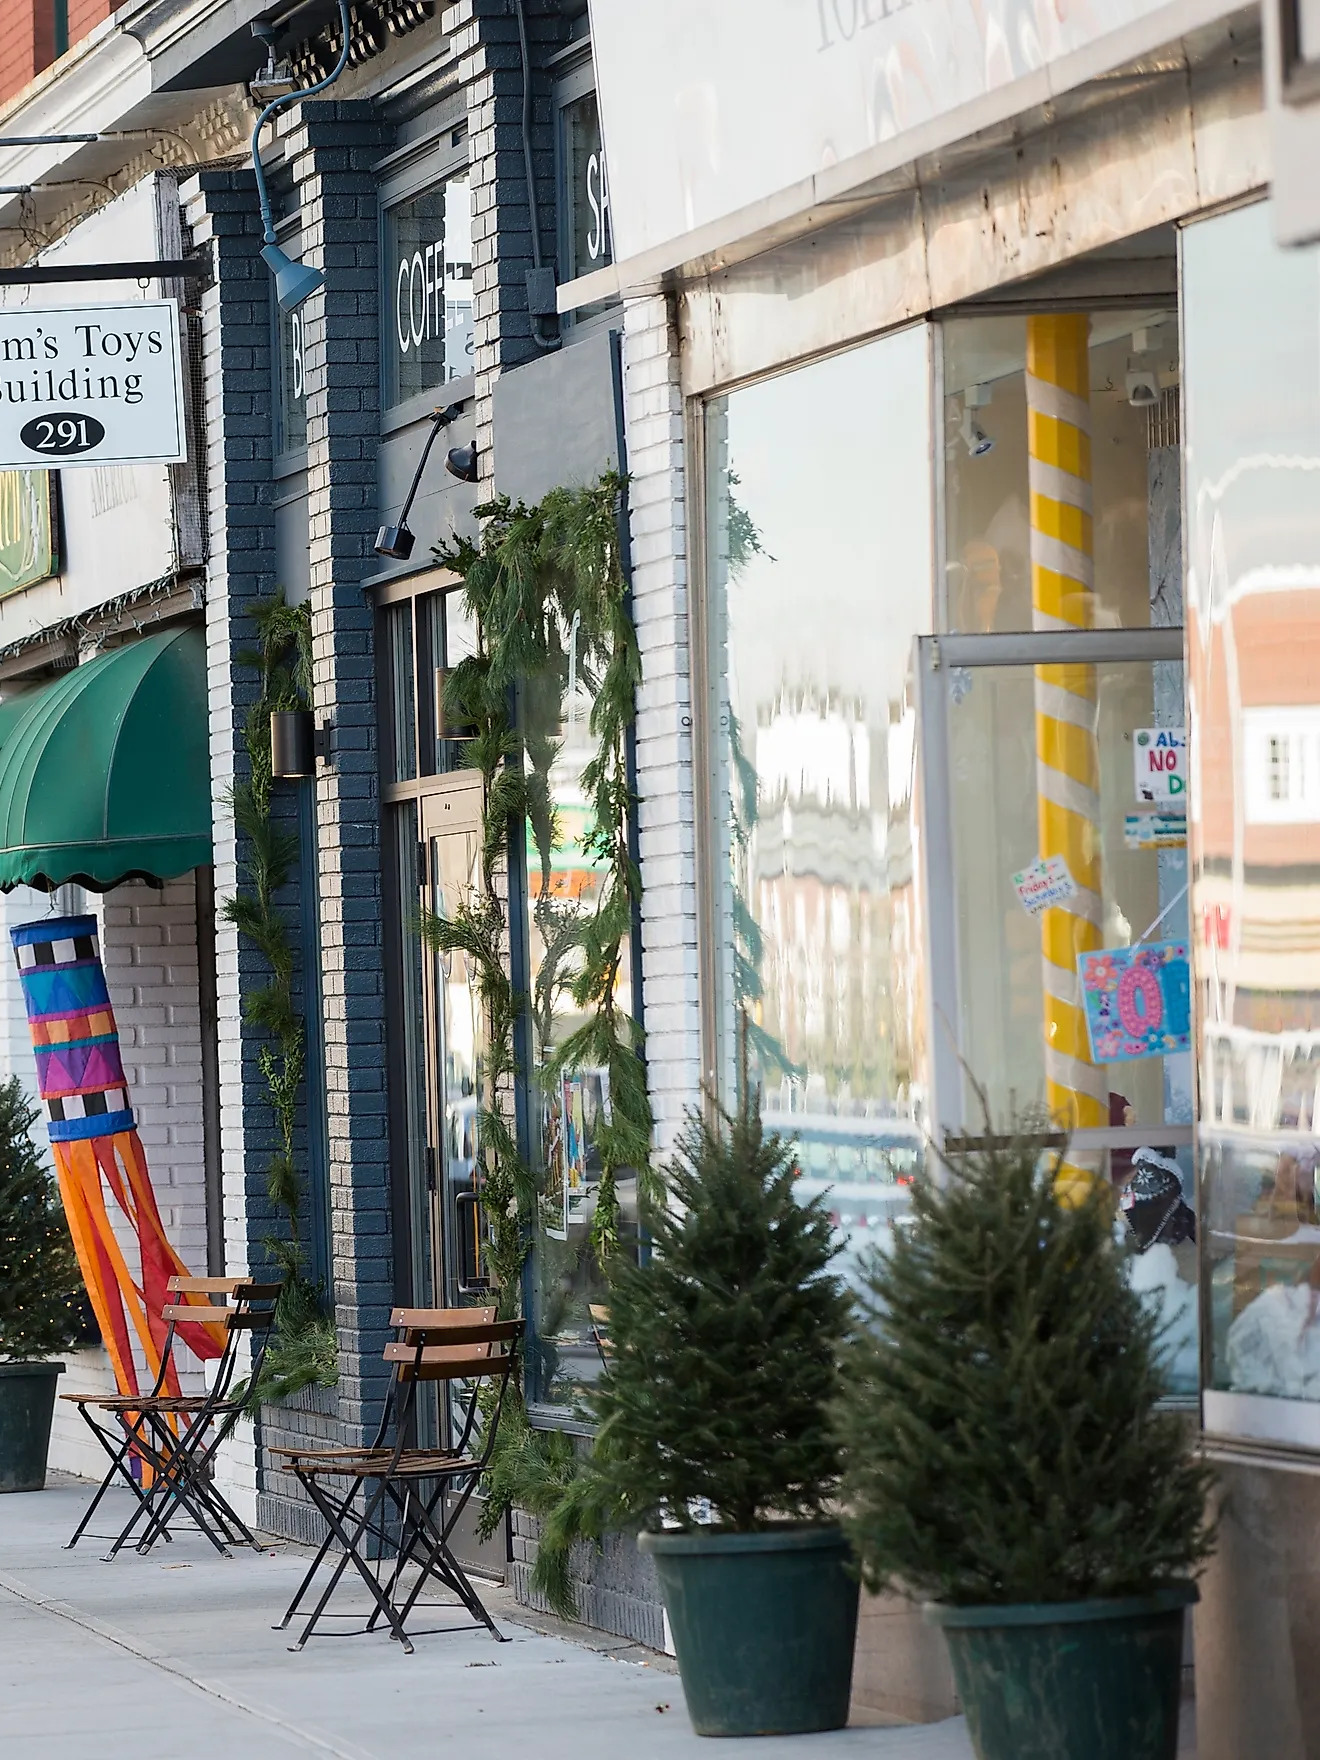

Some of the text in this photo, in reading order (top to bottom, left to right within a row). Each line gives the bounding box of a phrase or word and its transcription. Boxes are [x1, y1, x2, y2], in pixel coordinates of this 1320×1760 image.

[74, 324, 164, 363] Toys
[34, 418, 91, 450] 291
[1148, 750, 1178, 772] NO
